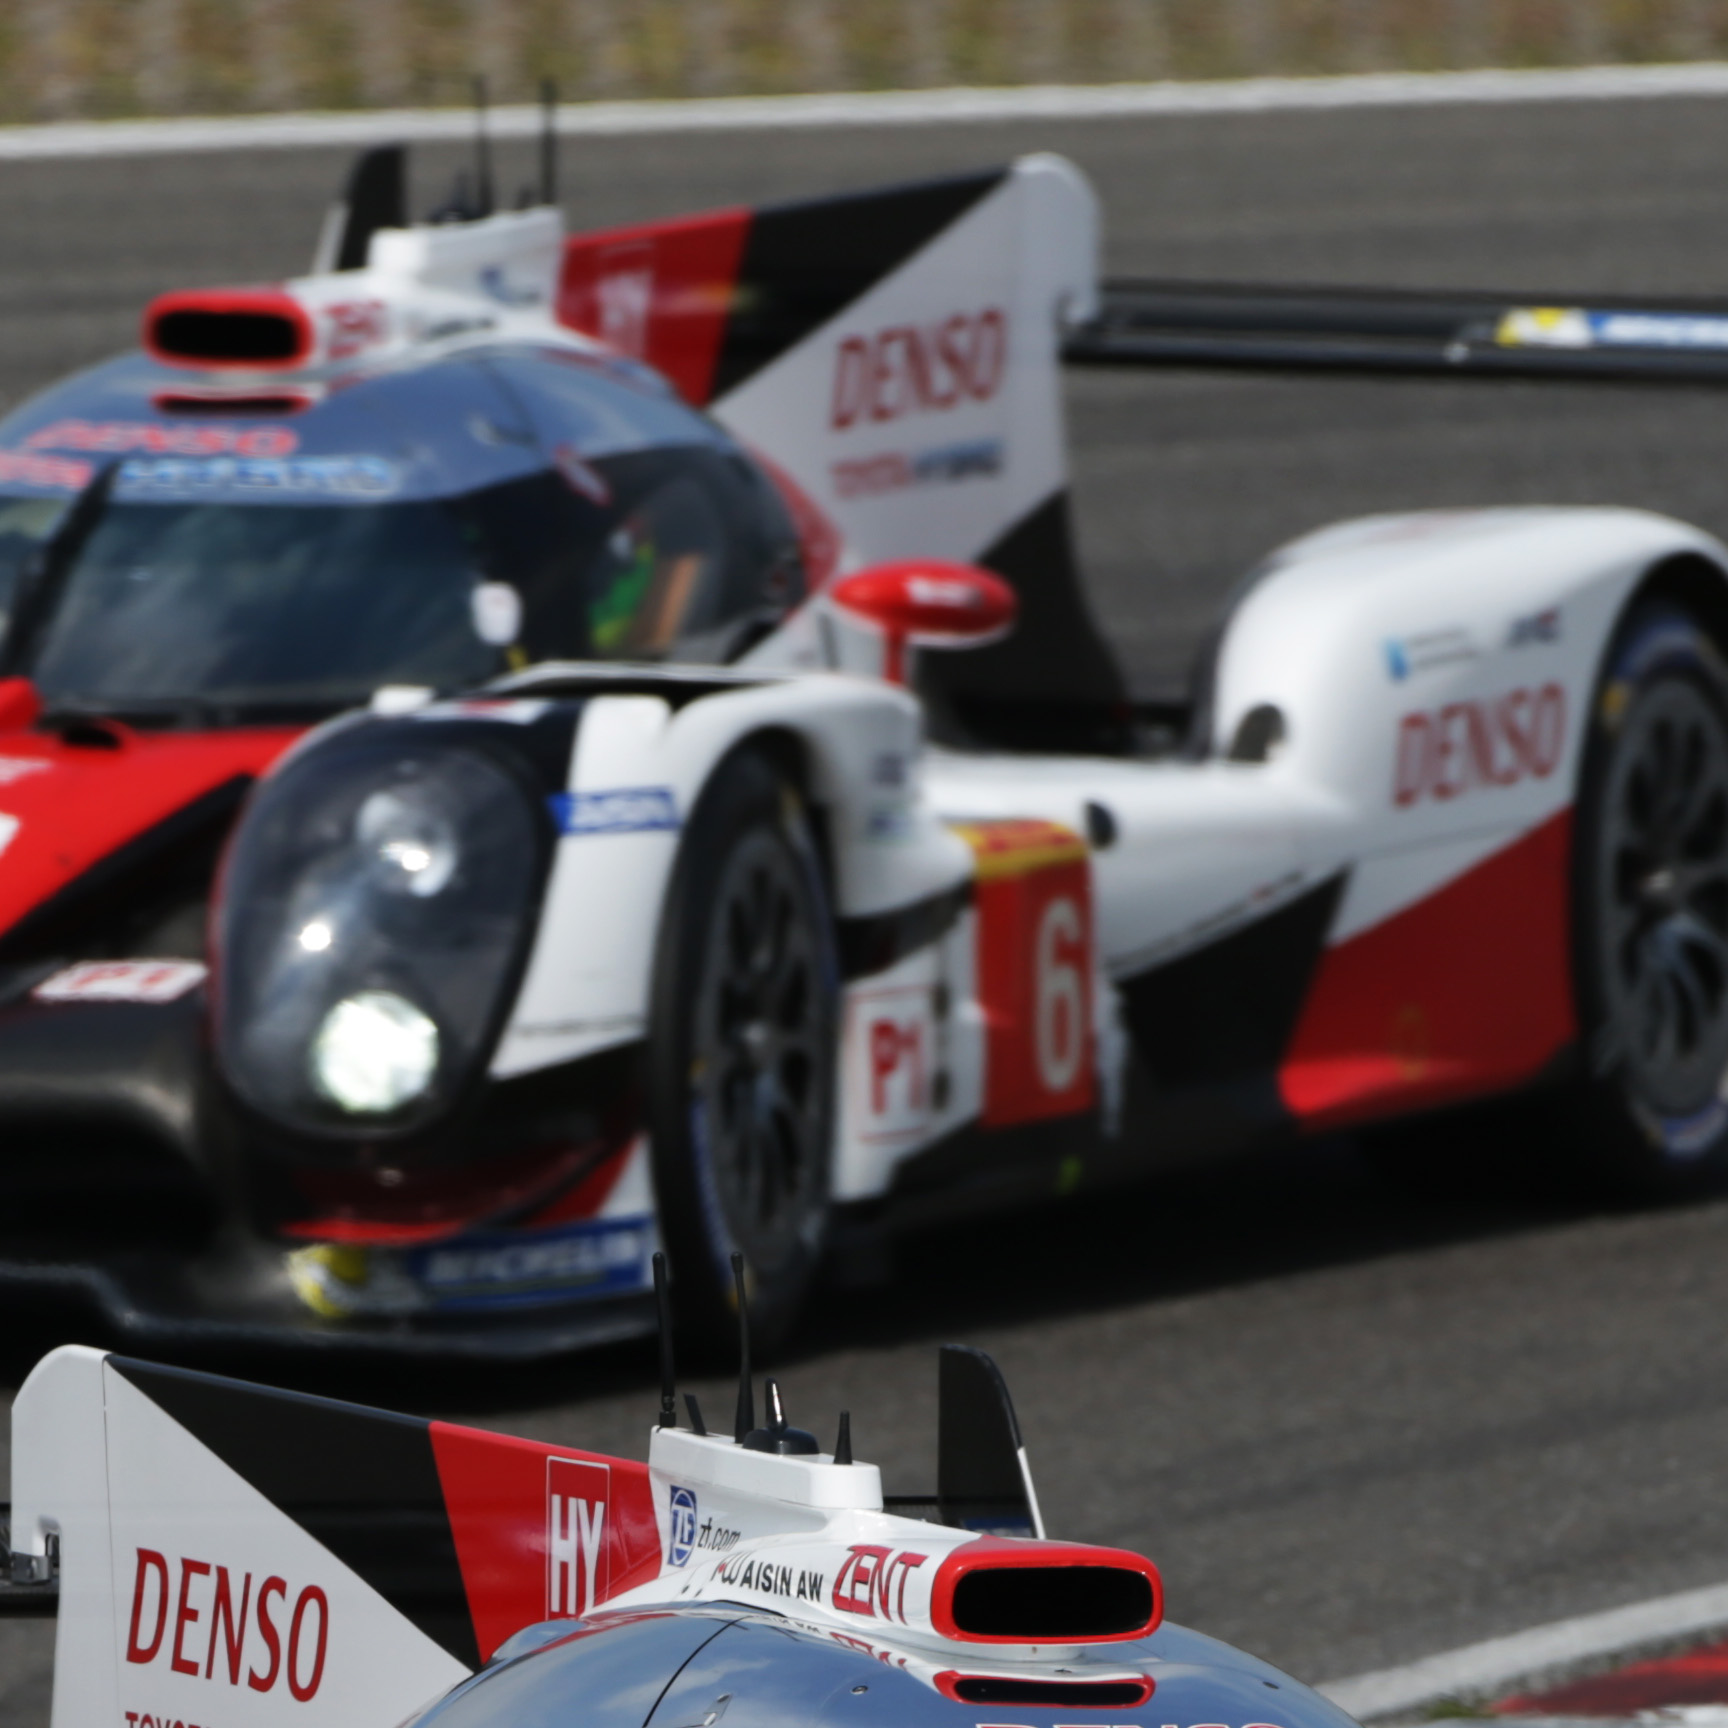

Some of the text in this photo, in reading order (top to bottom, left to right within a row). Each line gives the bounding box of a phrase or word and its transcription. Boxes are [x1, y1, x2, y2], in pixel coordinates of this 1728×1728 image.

[831, 309, 1005, 431] DENSO
[1392, 683, 1567, 809] DENSO
[1035, 898, 1082, 1090] 6
[550, 1493, 604, 1615] HY
[740, 1560, 792, 1597] AISIN
[796, 1570, 823, 1602] AW
[832, 1545, 929, 1625] ZENT
[125, 1547, 329, 1702] DENSO
